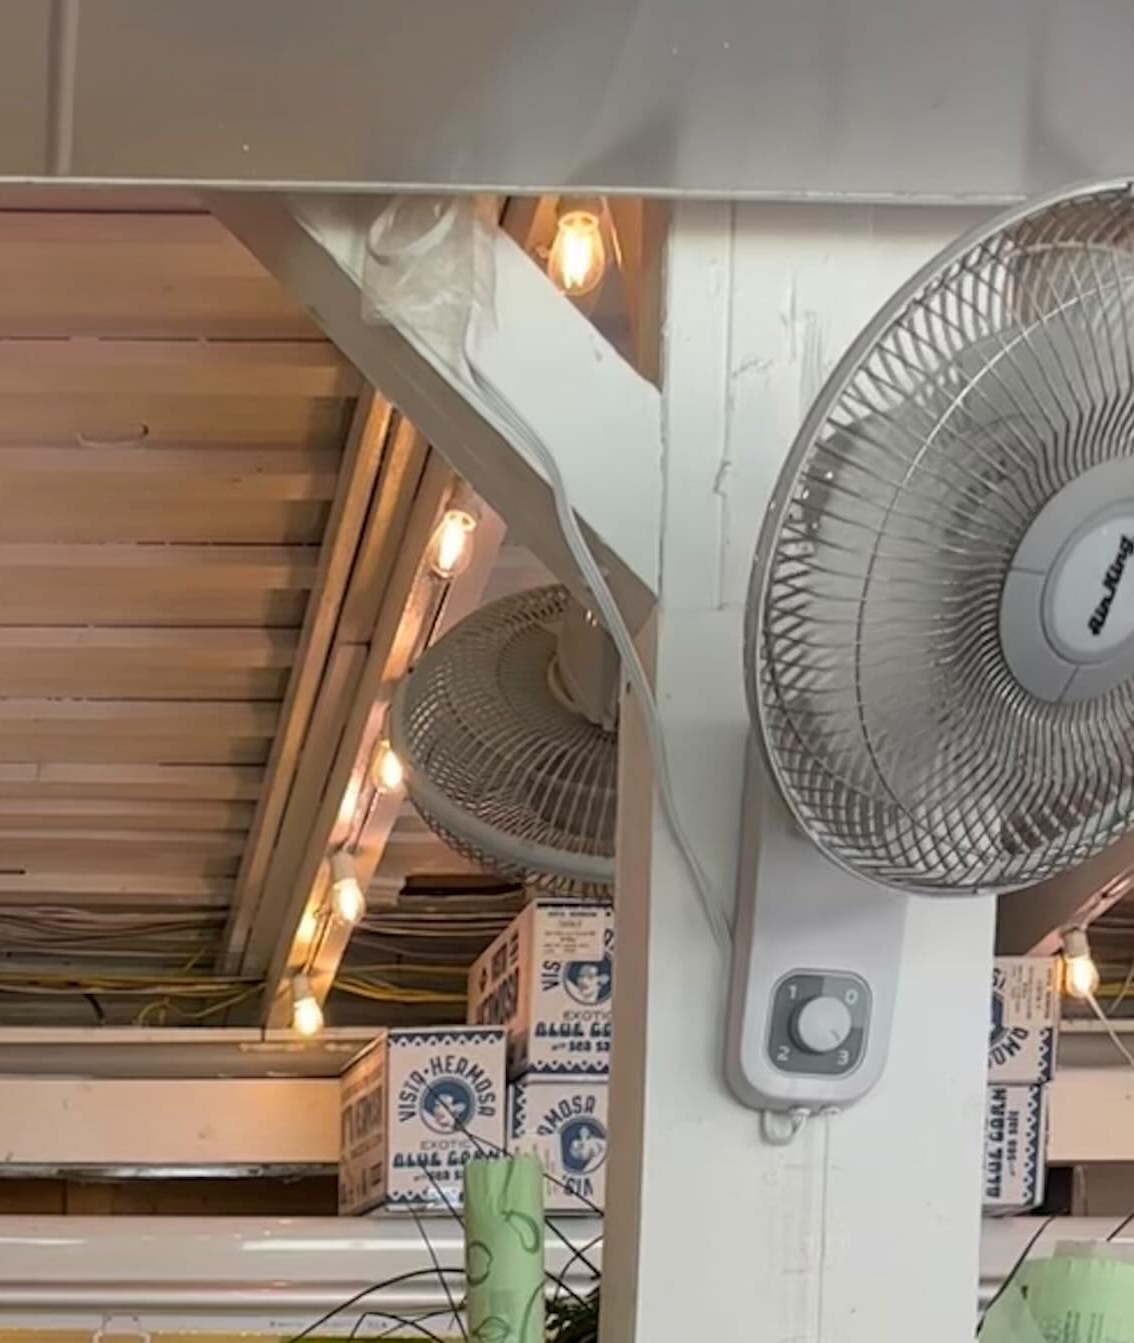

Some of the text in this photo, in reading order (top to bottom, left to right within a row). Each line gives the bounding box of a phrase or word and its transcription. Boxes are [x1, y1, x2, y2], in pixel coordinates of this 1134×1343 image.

[788, 984, 859, 1005] 1 0
[535, 1022, 584, 1037] BLUE
[777, 1045, 850, 1066] 2 3
[430, 1055, 497, 1117] HERMOSA
[986, 1087, 1007, 1199] BLUE CORN
[393, 1153, 441, 1167] BLUE
